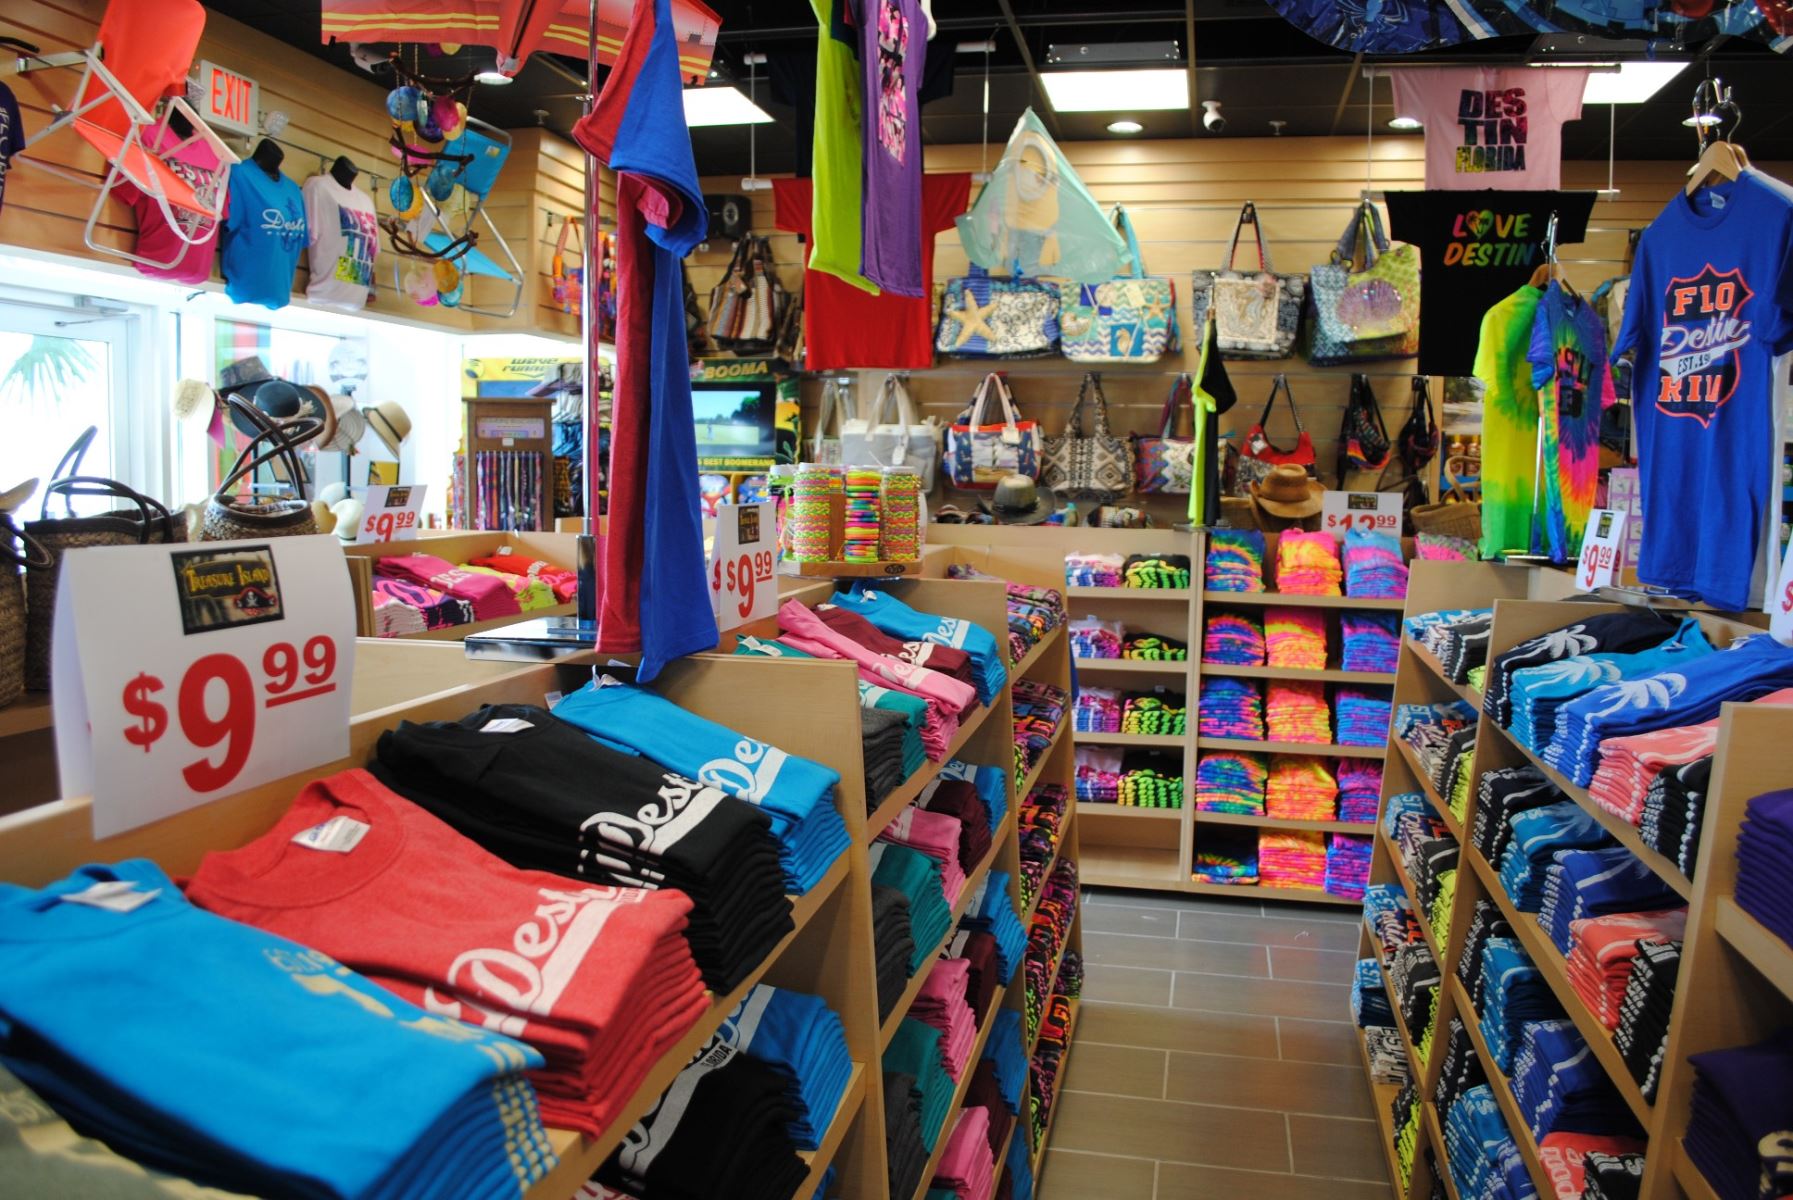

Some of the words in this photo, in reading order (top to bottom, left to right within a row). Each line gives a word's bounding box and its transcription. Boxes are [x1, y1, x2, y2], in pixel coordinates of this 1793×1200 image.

[211, 67, 252, 125] EXIT
[1457, 86, 1528, 119] DES
[1457, 116, 1528, 146] TIN
[1455, 144, 1527, 174] FLORIDA
[1443, 241, 1537, 267] DESTIN
